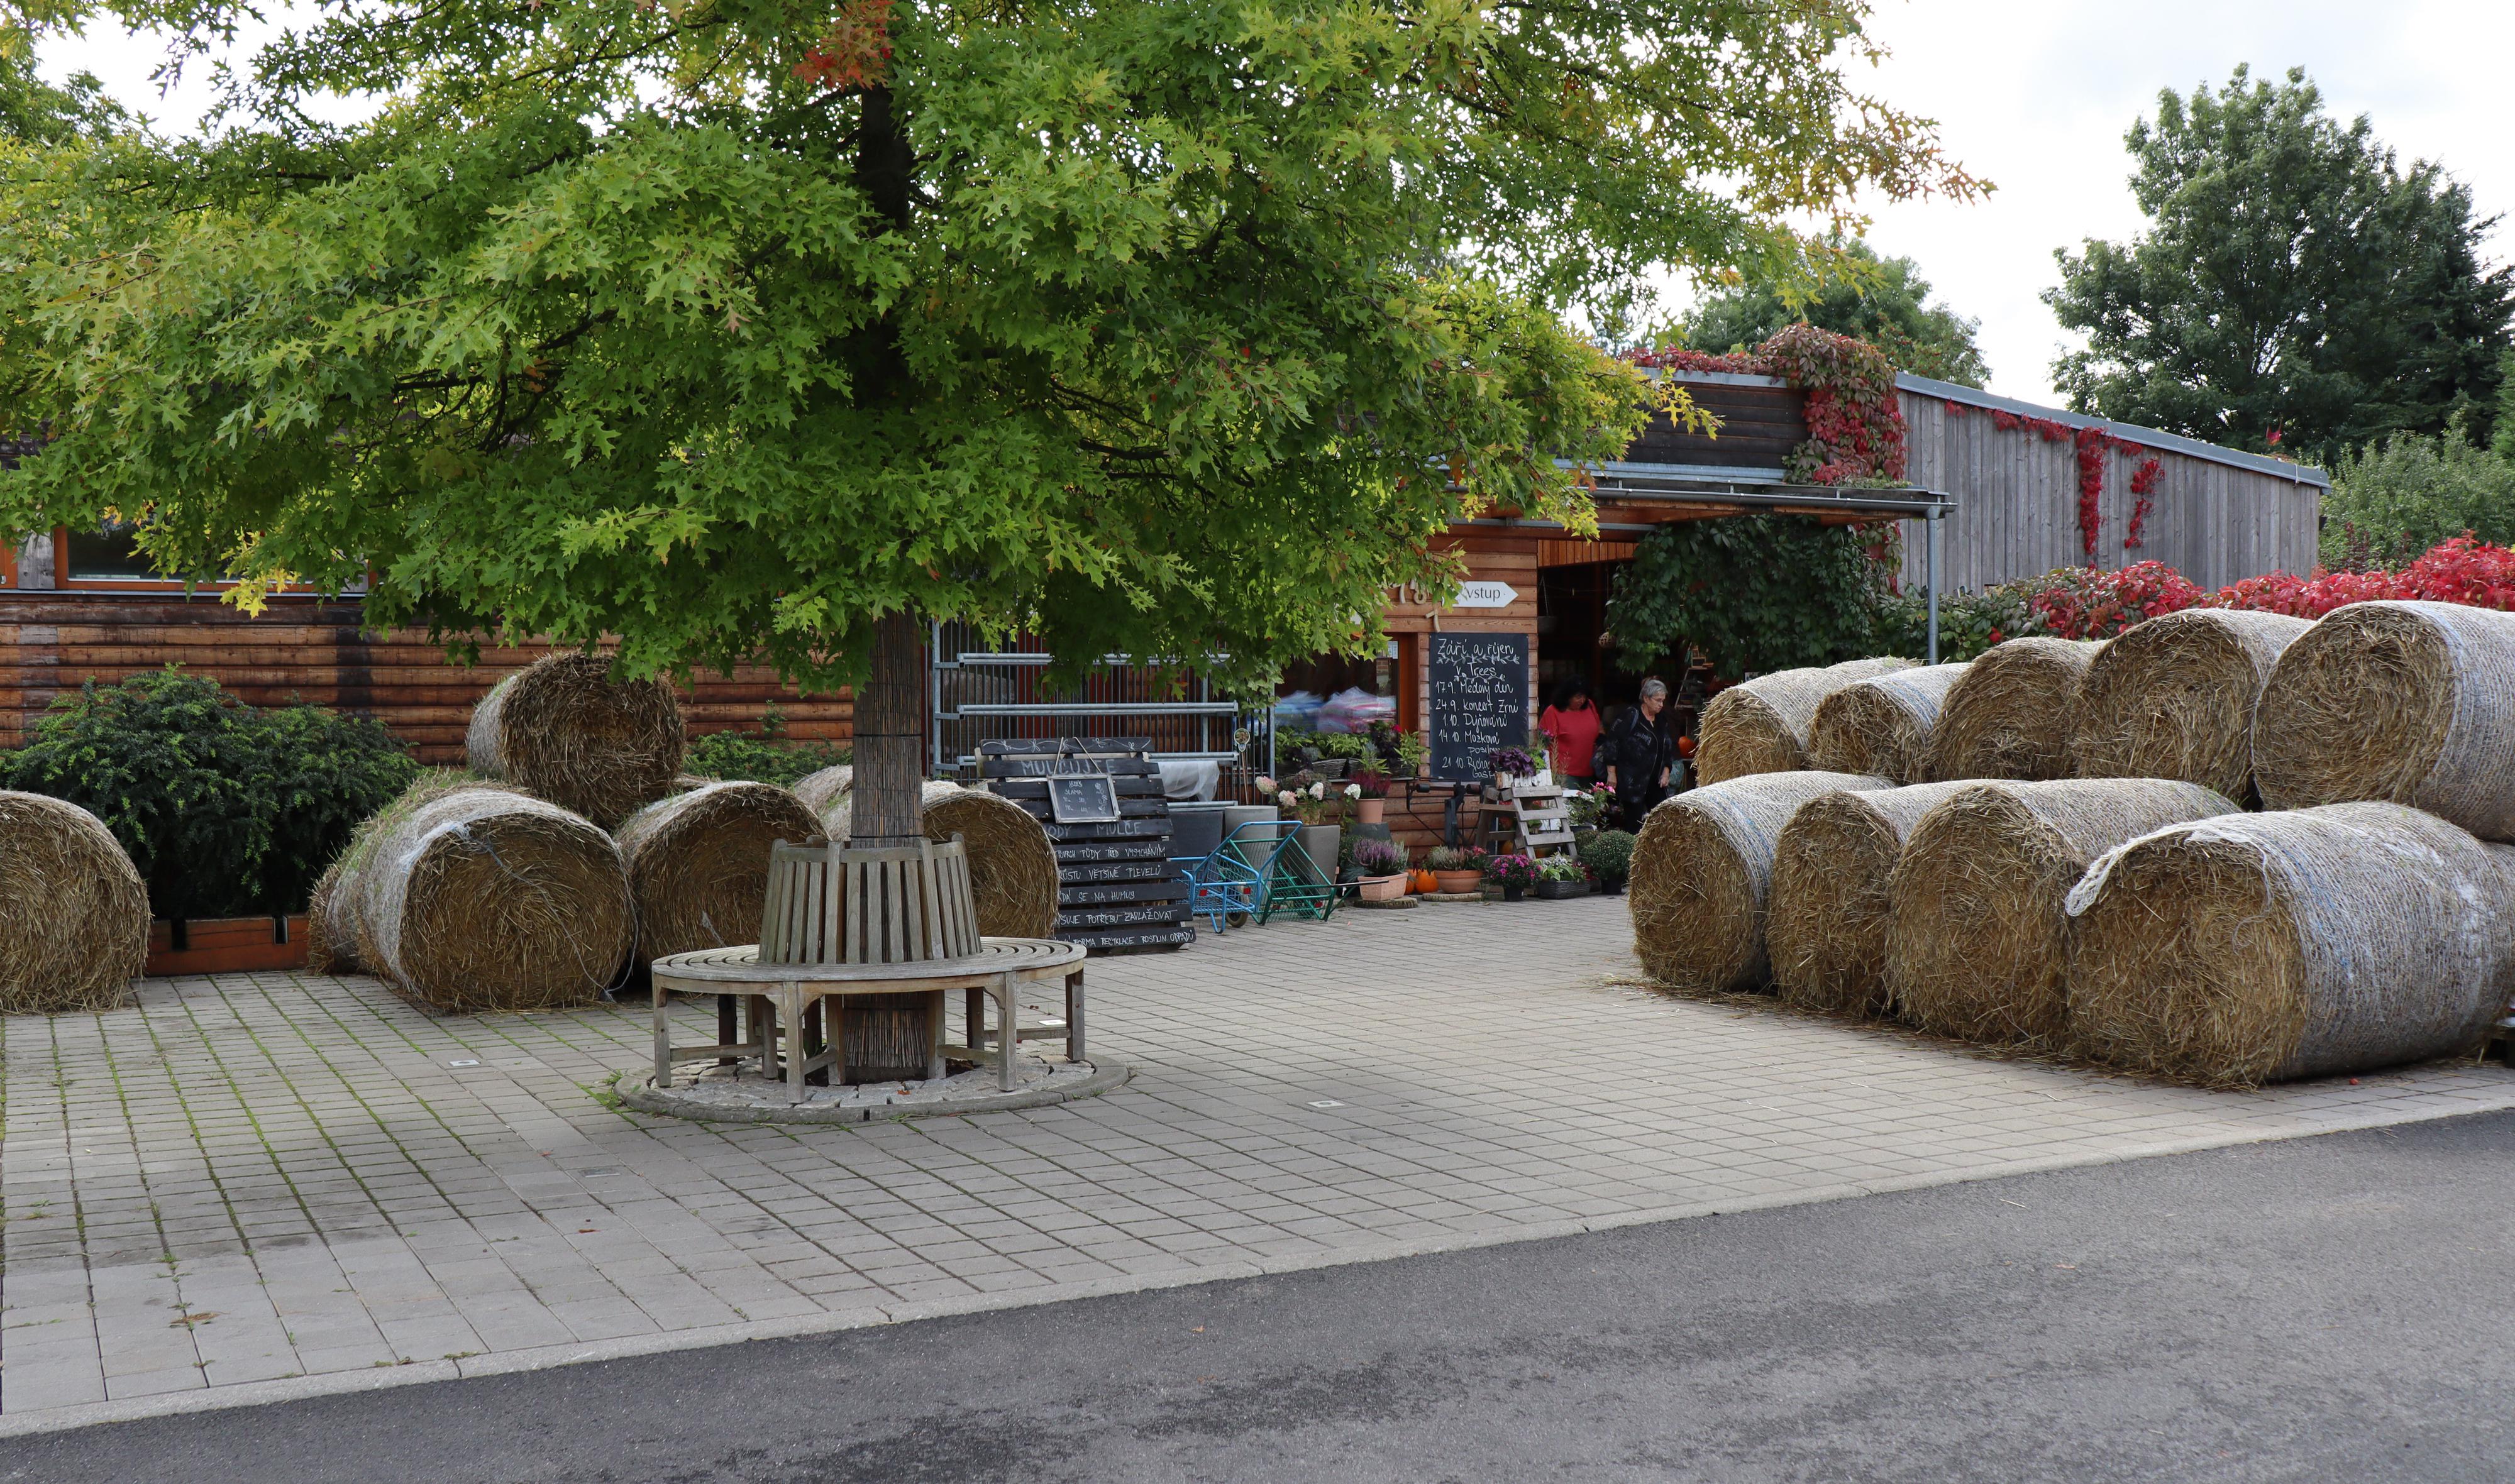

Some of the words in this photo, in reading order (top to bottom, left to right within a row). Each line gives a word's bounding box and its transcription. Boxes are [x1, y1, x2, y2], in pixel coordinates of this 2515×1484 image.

[1466, 588, 1501, 602] vstup
[1473, 644, 1483, 656] a
[1467, 662, 1496, 677] Trees
